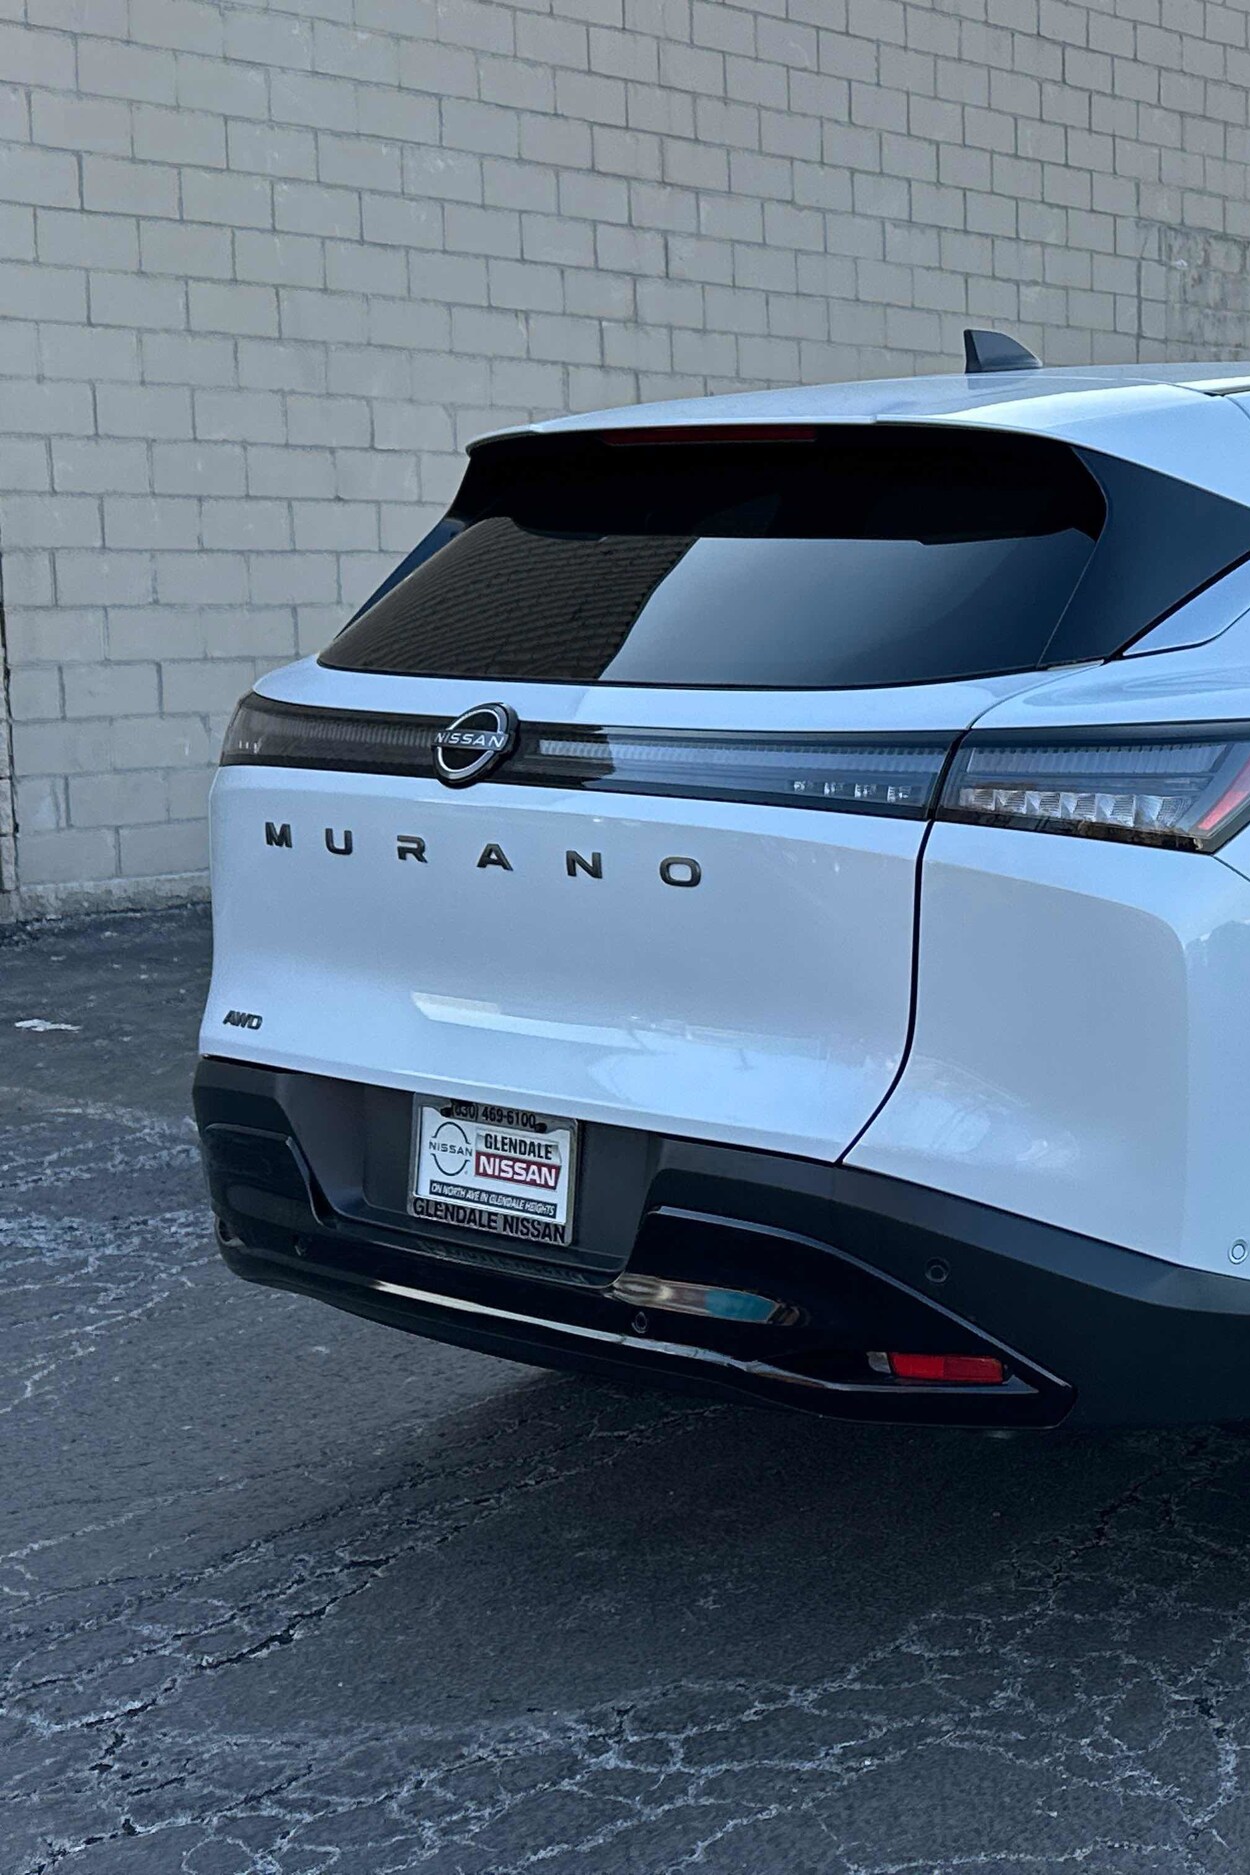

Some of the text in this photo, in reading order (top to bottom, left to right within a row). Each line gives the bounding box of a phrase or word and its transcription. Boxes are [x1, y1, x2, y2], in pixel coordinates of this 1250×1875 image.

[434, 732, 504, 748] NISSAN
[264, 821, 703, 888] MURANO
[222, 1010, 263, 1030] AWD
[482, 1106, 536, 1129] 469-6100
[429, 1141, 473, 1157] NISSAN
[484, 1133, 552, 1160] GLENDALE
[479, 1155, 556, 1187] NISSAN
[431, 1183, 556, 1216] ON NORTH AVE IN GLENDALE HEIGHTS
[413, 1197, 565, 1243] GLENDALE NISSAN
